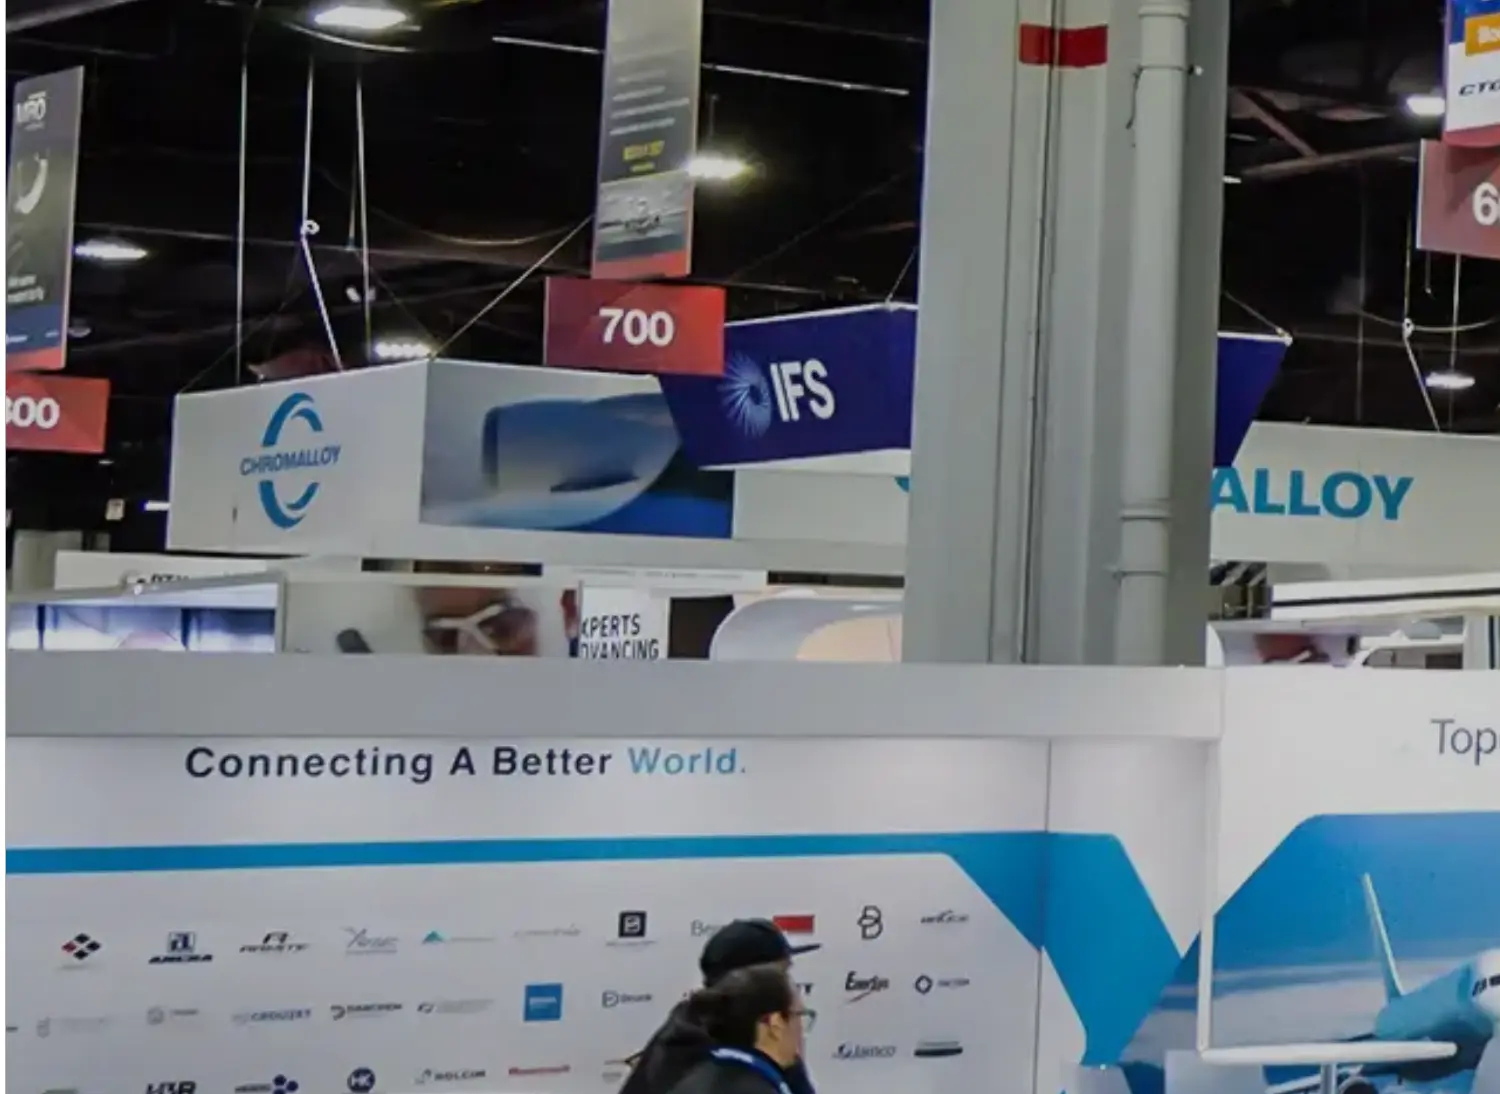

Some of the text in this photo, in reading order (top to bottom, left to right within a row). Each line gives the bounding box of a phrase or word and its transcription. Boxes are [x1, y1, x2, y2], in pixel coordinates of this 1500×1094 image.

[598, 307, 675, 347] 700
[768, 359, 837, 423] IFS
[239, 443, 343, 478] CHROMALLOY
[184, 745, 748, 785] Connecting A Better World.
